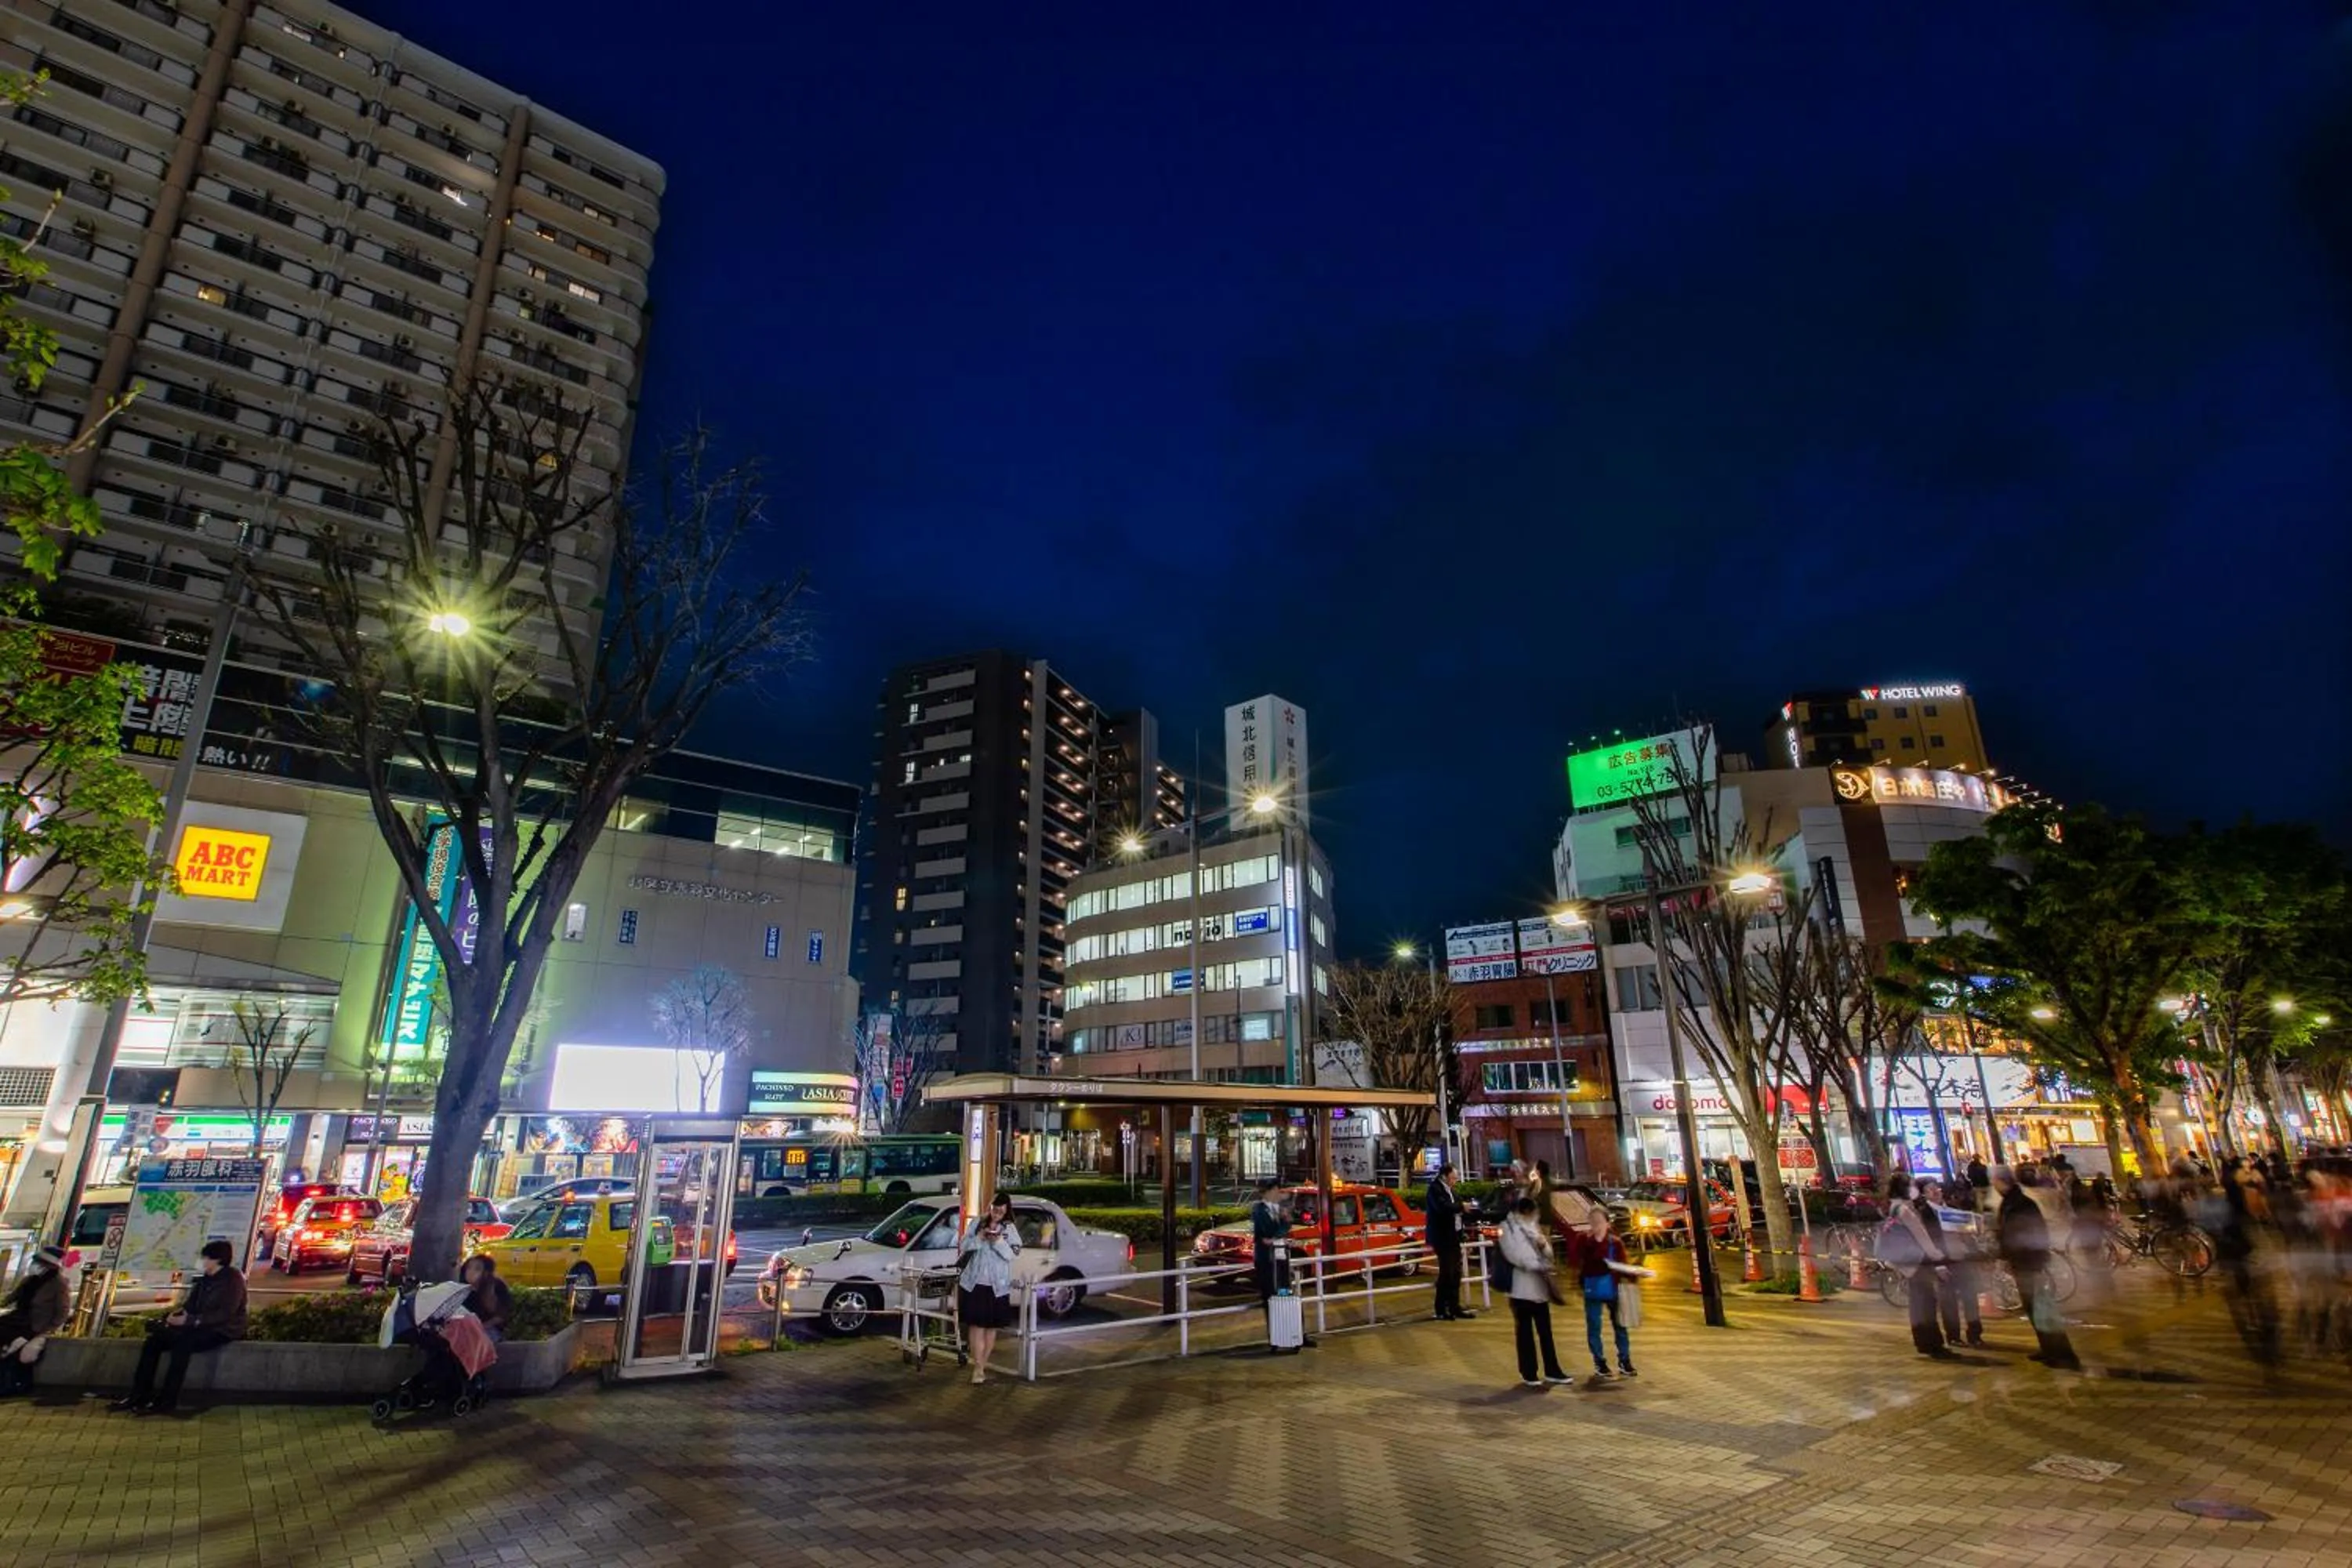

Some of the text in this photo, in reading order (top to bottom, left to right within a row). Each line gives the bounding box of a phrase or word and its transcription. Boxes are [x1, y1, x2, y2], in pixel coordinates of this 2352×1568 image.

[1882, 687, 1921, 699] HOTEL
[1922, 684, 1962, 698] WING
[189, 841, 256, 869] ABC
[184, 865, 251, 887] MART
